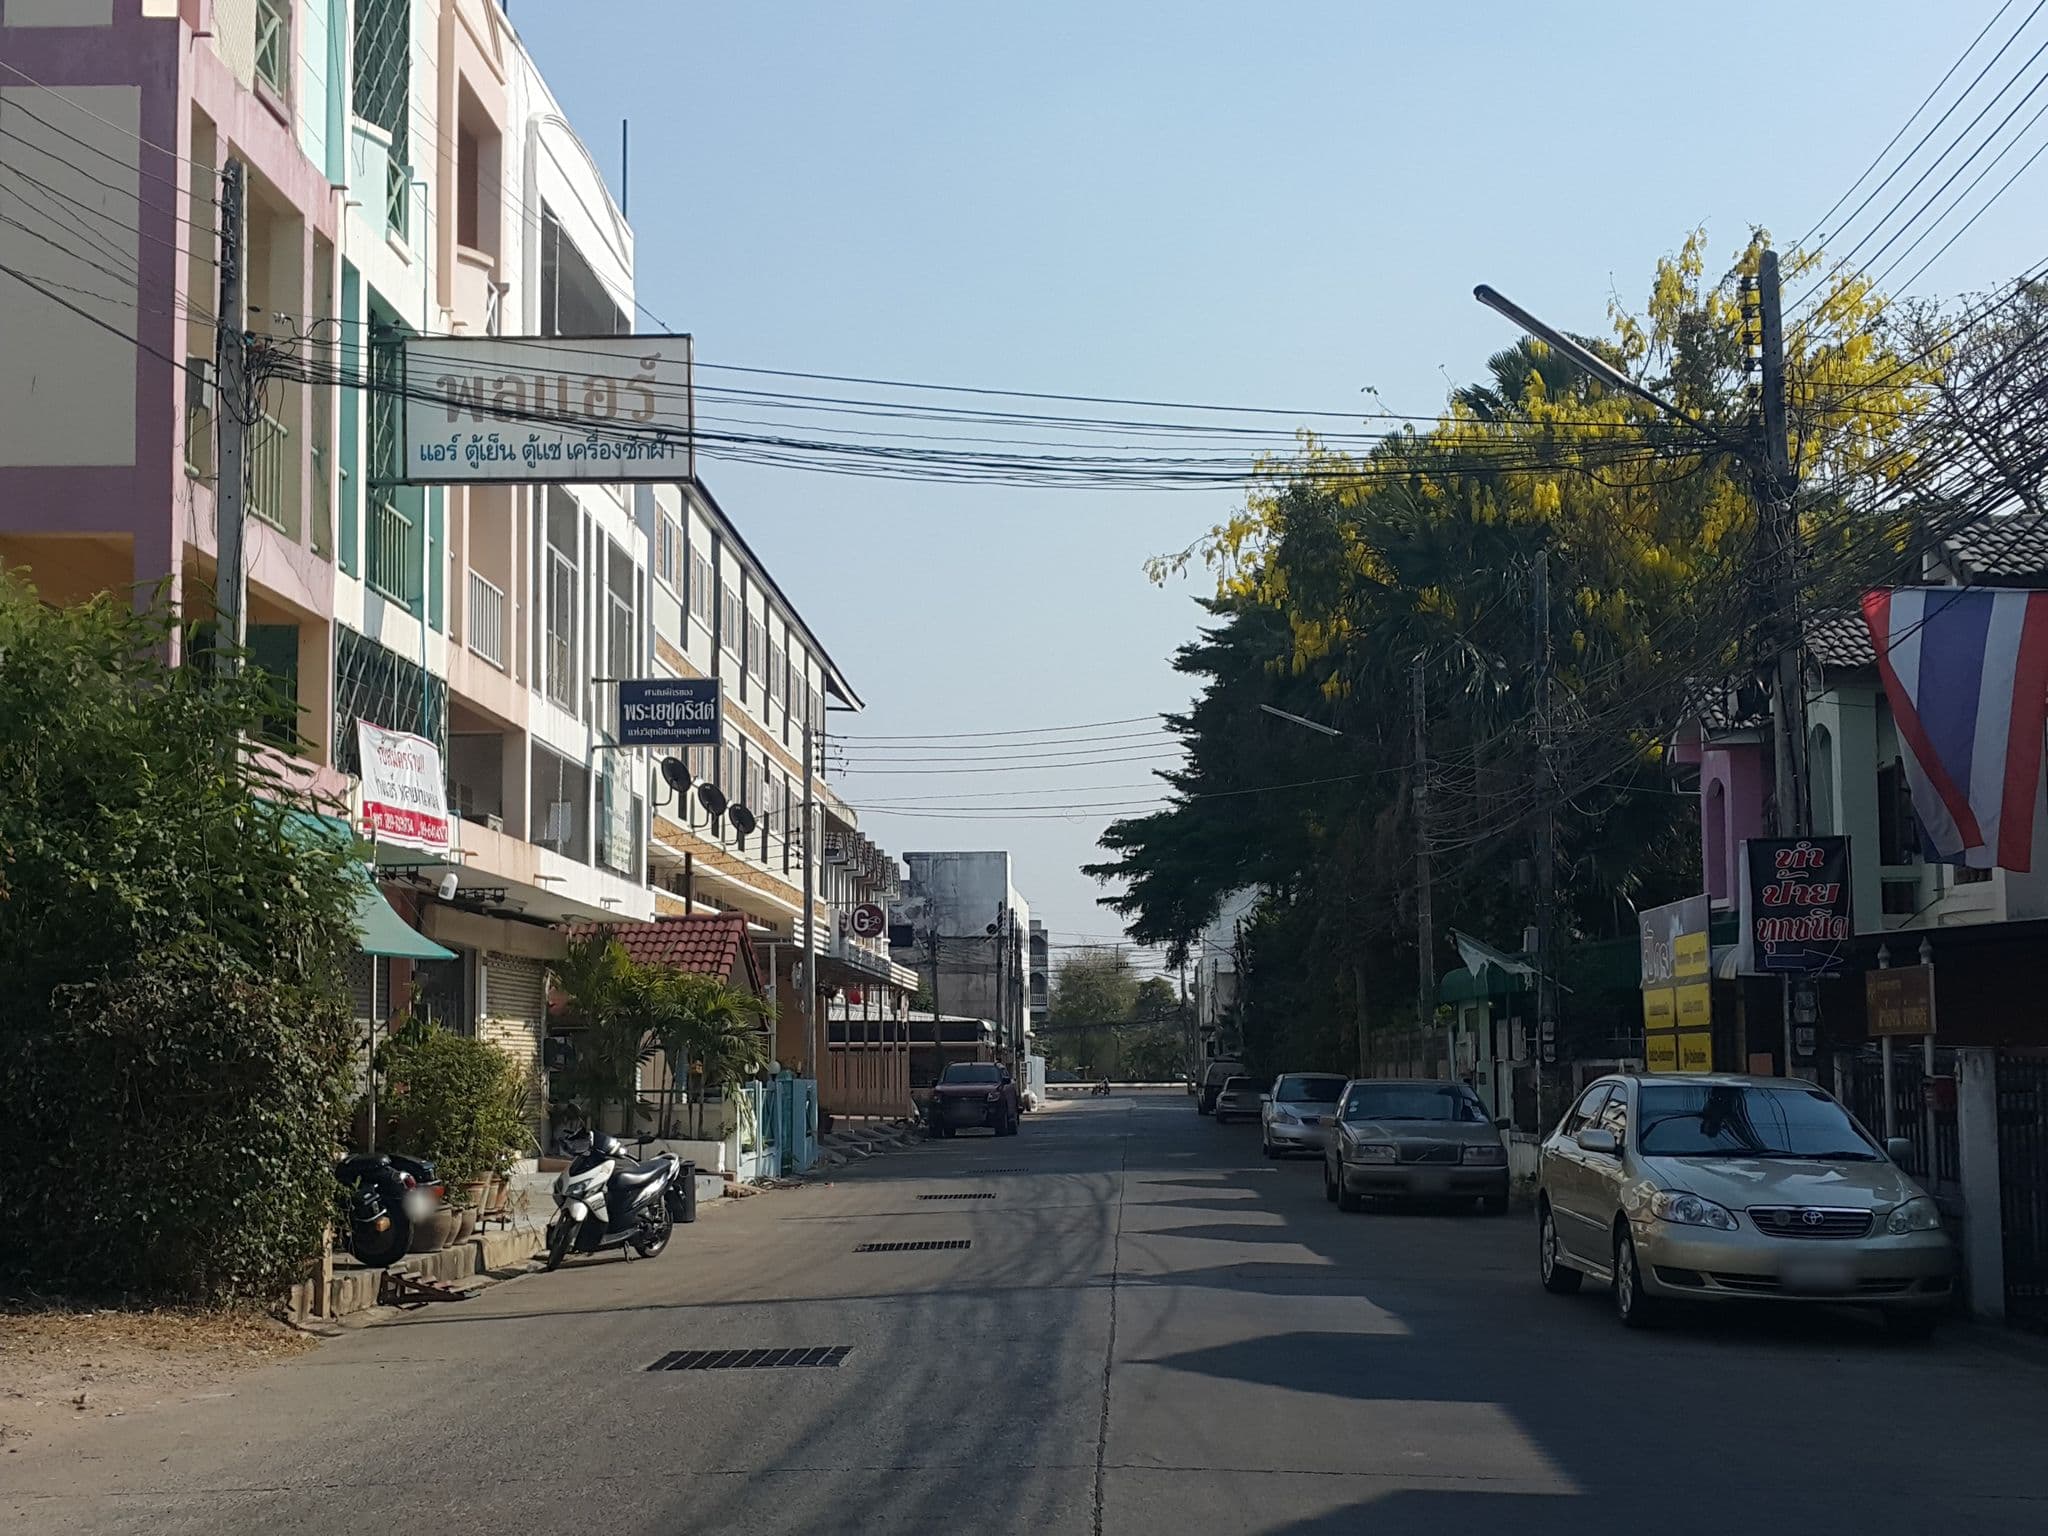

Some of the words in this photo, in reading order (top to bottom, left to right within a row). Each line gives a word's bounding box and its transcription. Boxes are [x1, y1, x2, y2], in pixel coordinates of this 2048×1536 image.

[419, 433, 462, 462] แอร์
[465, 432, 516, 469] ตู้เย็น
[522, 433, 564, 469] ตู้แช่
[624, 697, 716, 727] พระเยซูคริสต์
[1775, 840, 1825, 869] ทำ
[1762, 869, 1841, 907] ป้าย
[1756, 907, 1850, 955] ทุกชนิด
